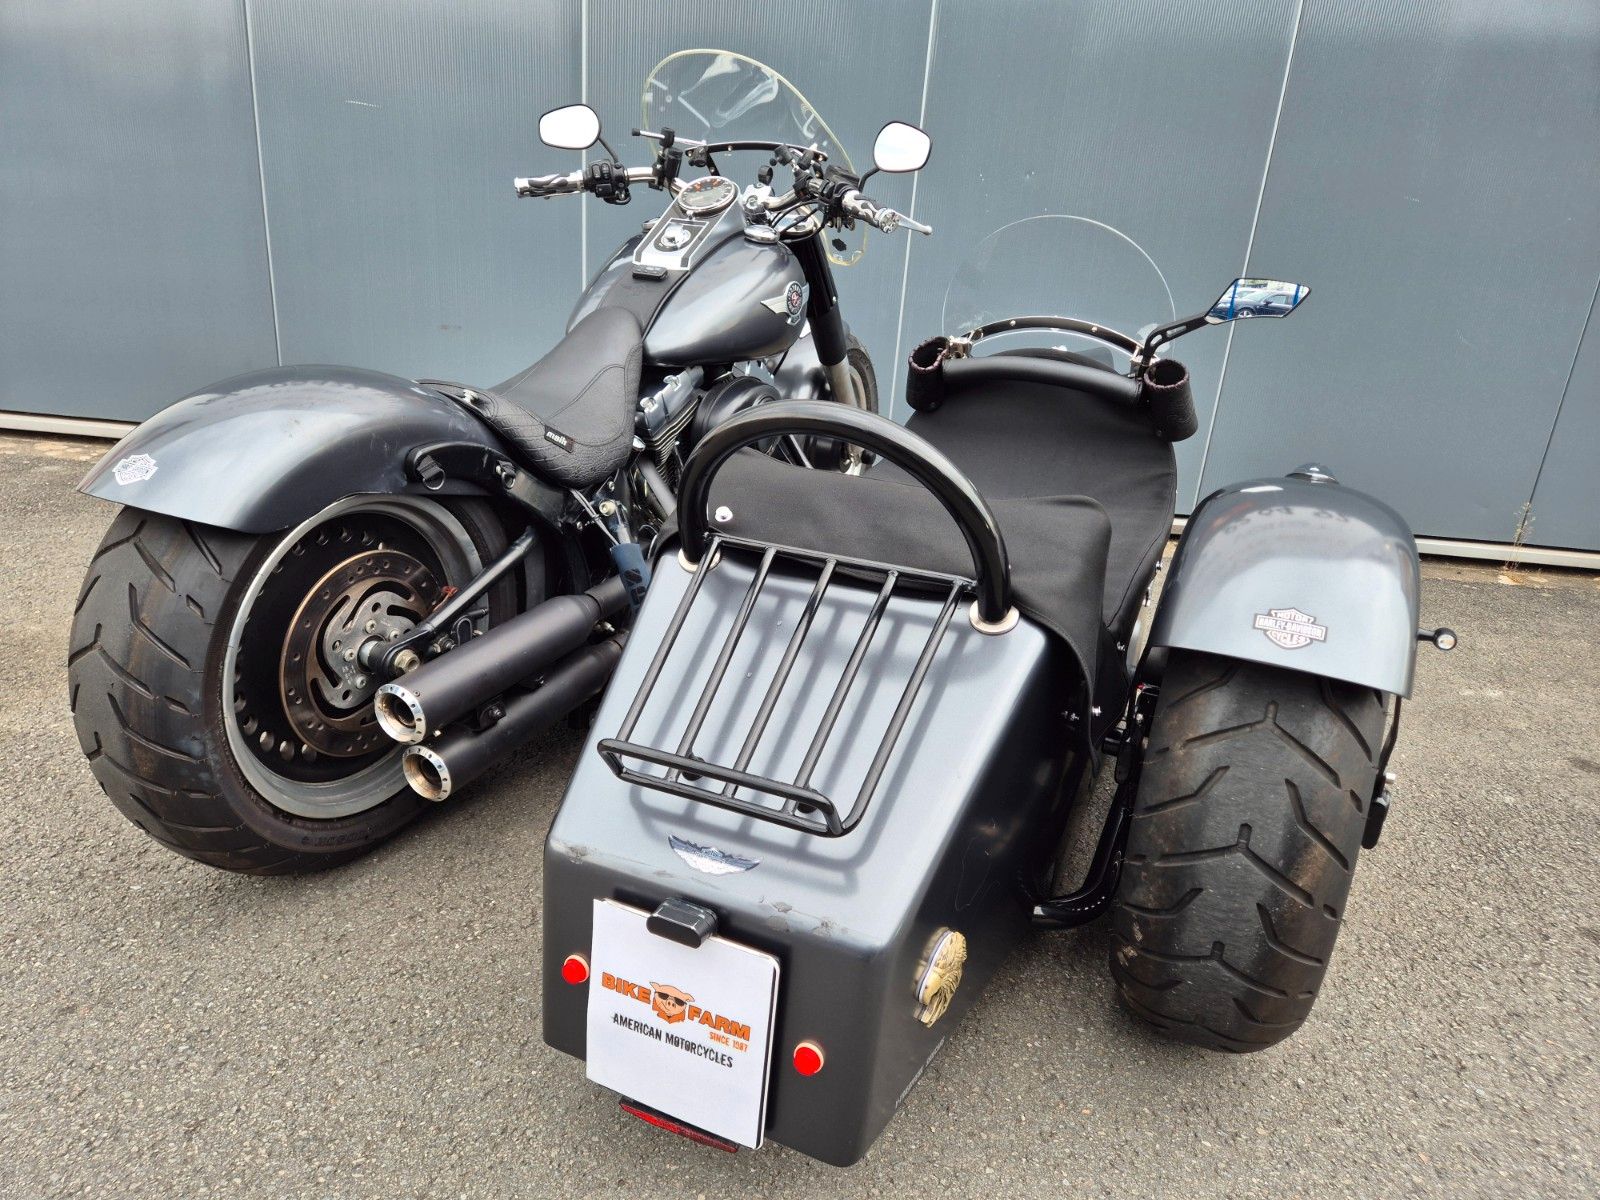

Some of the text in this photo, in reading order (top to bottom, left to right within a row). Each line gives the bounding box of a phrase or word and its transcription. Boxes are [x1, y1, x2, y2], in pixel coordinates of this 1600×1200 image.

[601, 971, 752, 1042] BIKE FARM
[612, 1012, 734, 1069] AMERICAN MOTORCYCLES
[709, 1031, 749, 1053] SINCE 1987
